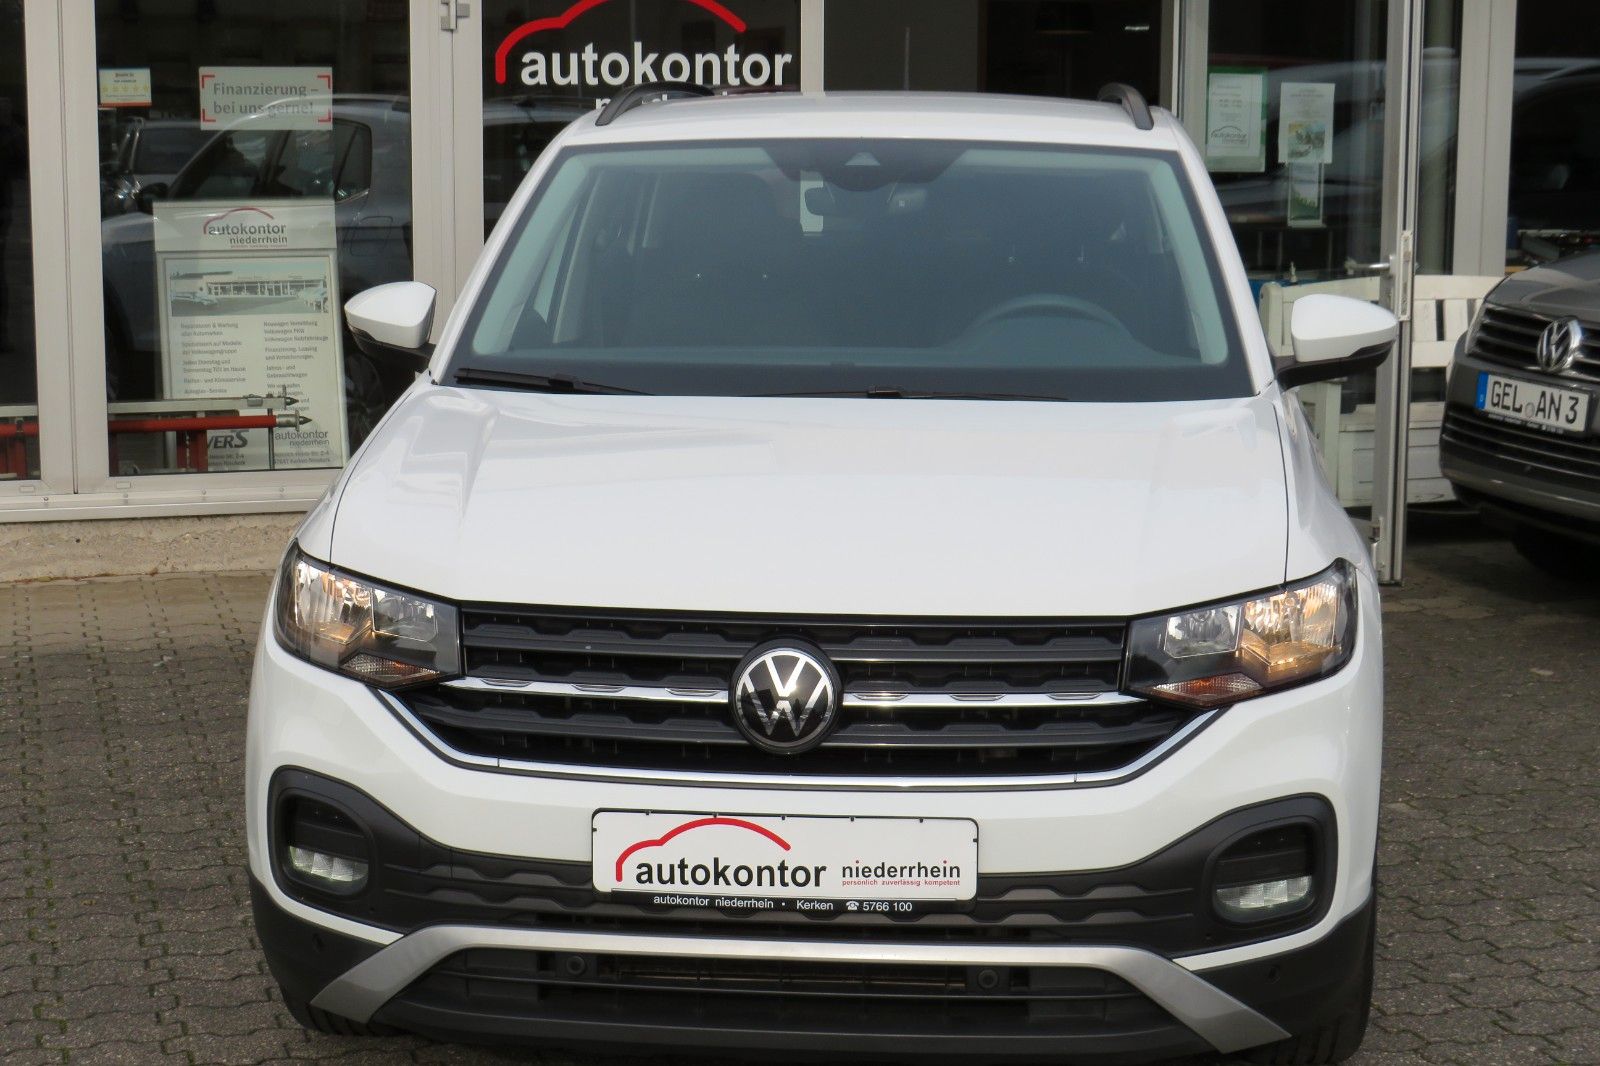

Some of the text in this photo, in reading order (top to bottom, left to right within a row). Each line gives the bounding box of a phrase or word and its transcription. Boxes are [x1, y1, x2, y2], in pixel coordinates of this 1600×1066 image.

[520, 41, 793, 86] autokontor
[213, 82, 307, 97] Finanzierung
[213, 101, 314, 117] bei uns gerne!
[208, 222, 287, 236] autokontor
[230, 234, 288, 245] niederrhein
[1490, 380, 1523, 414] GEL
[1535, 389, 1562, 421] AN
[1565, 395, 1580, 424] 3
[208, 429, 250, 449] VERS
[275, 430, 329, 440] autokontor
[635, 856, 961, 889] autokontor niederrhein
[923, 879, 961, 887] kompetent
[653, 895, 913, 912] autokontor niederrhein Kerken 5766 100
